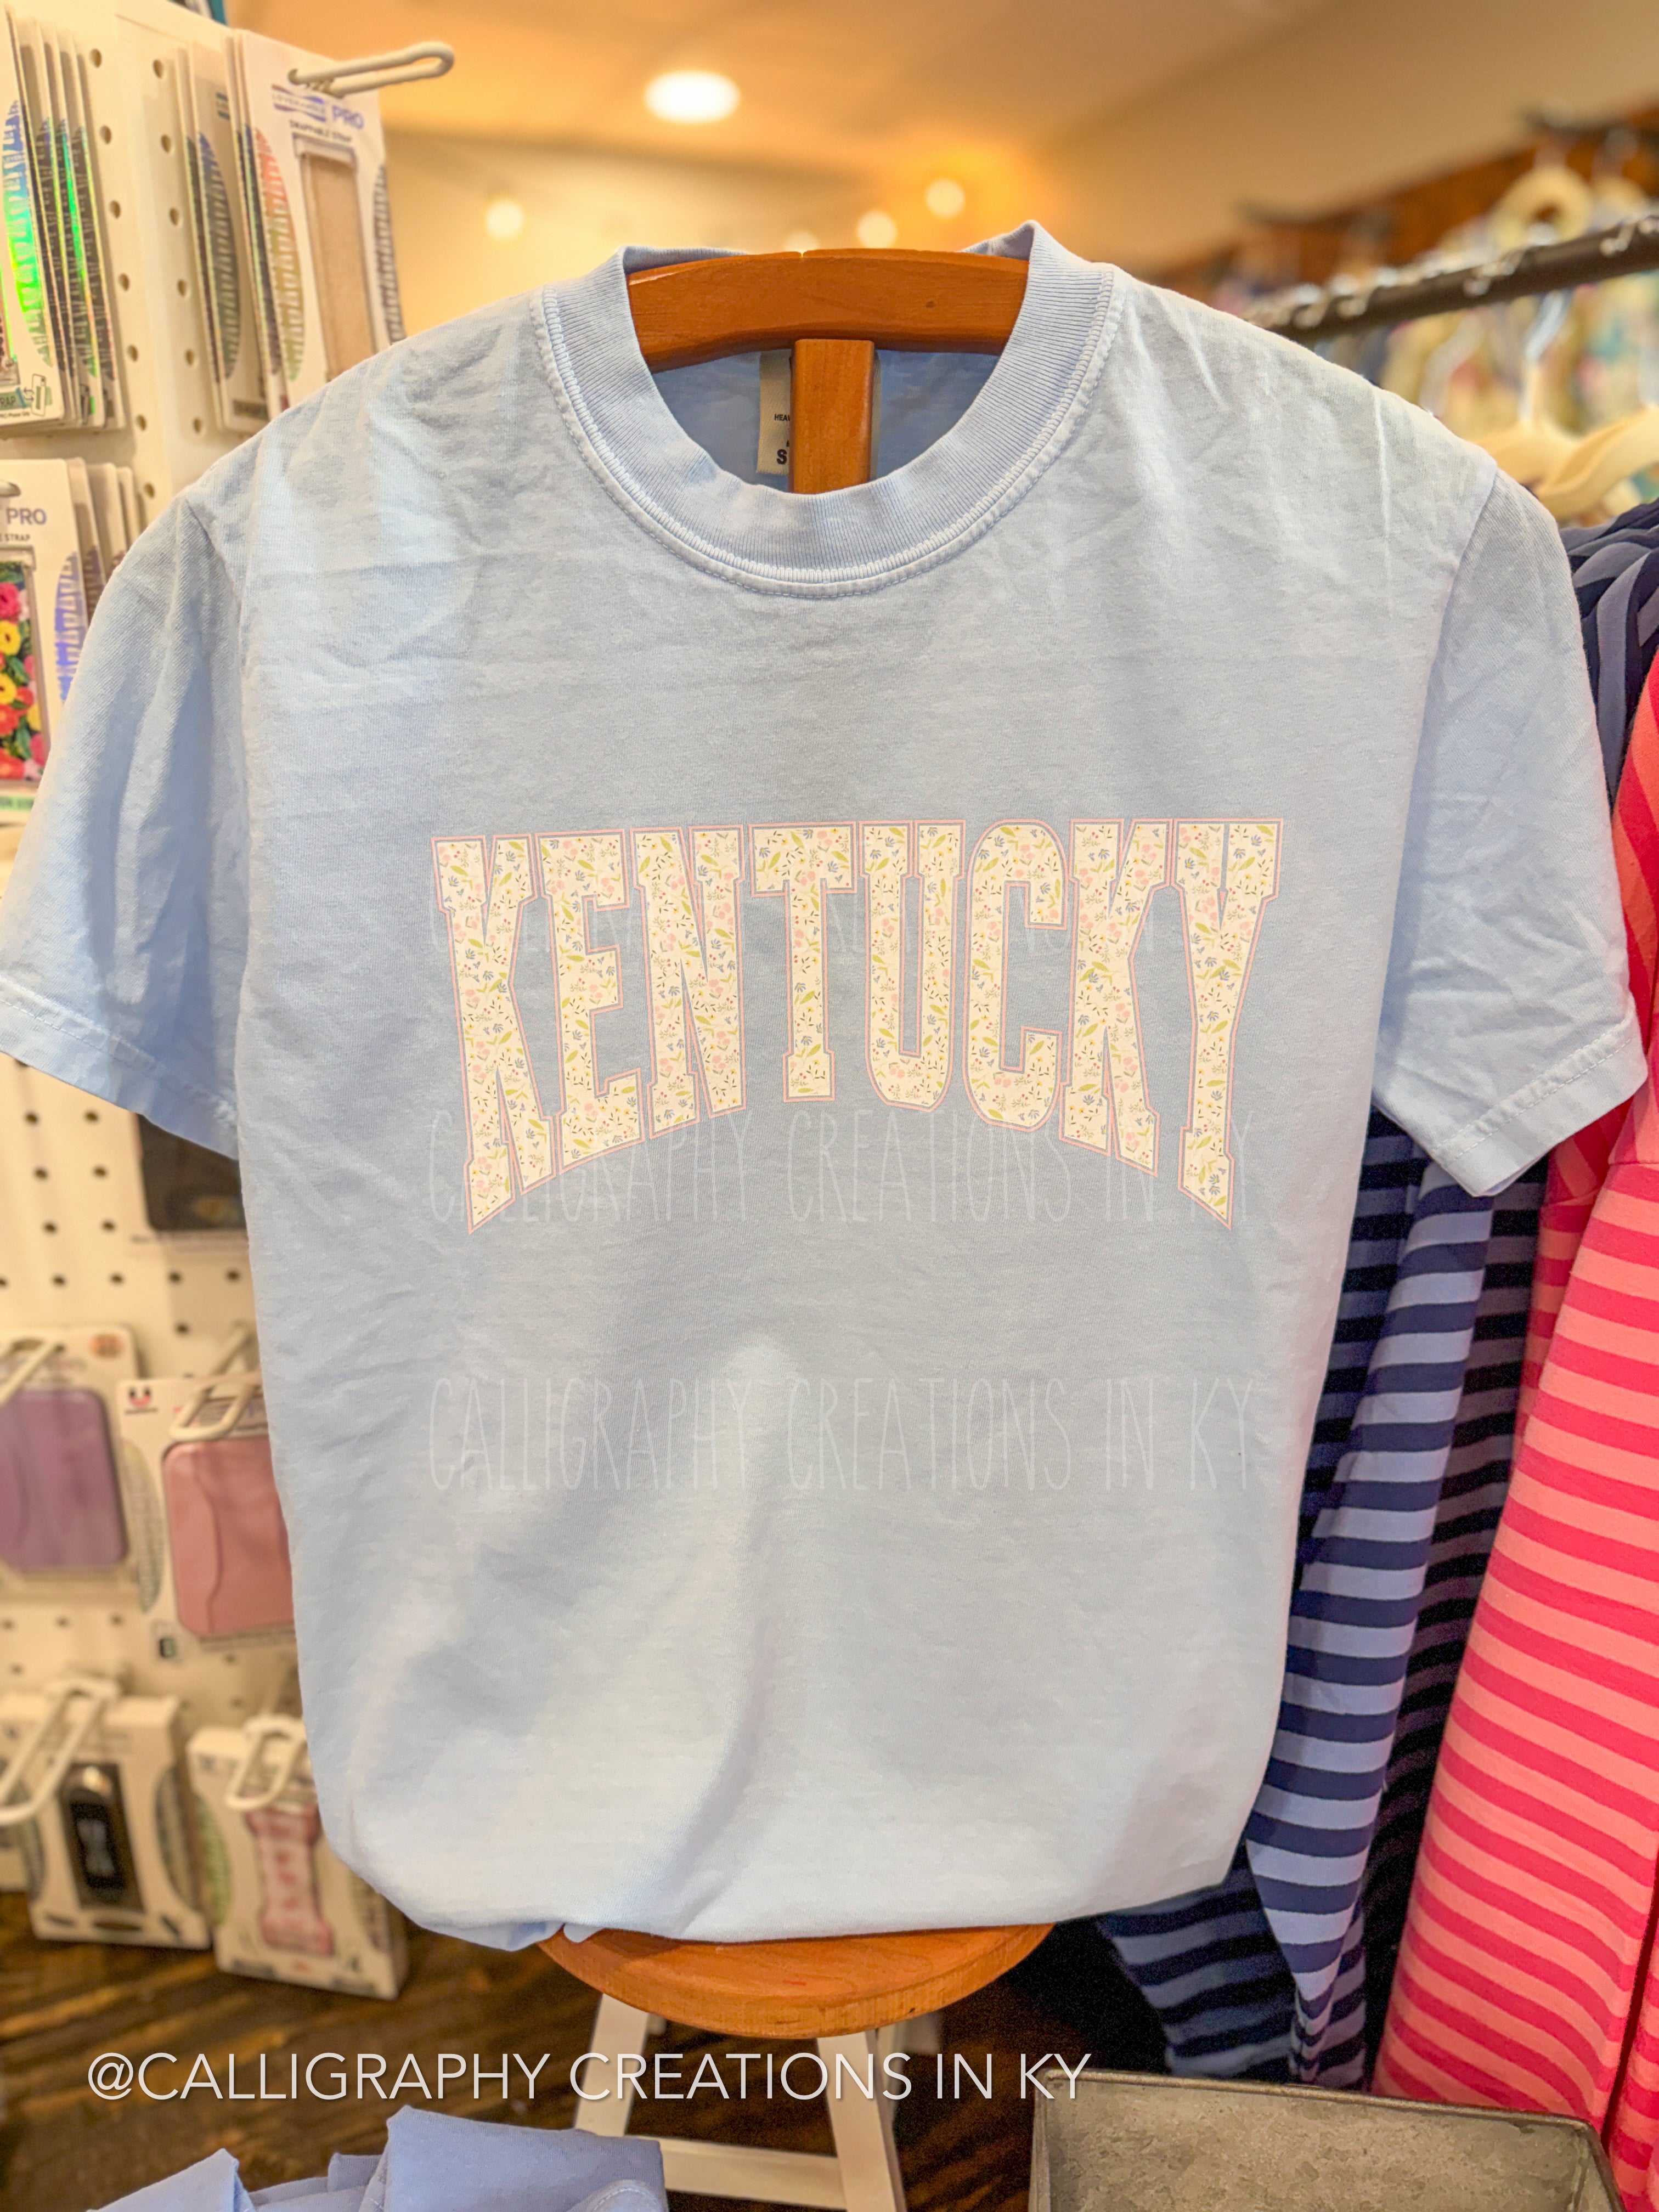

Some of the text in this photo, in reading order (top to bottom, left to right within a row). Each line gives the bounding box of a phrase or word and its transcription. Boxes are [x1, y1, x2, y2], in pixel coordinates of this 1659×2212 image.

[332, 105, 364, 129] PRO
[776, 449, 787, 465] S
[5, 507, 47, 525] PRO
[4, 533, 31, 542] STRAP
[431, 819, 1284, 1233] KENTUCKY
